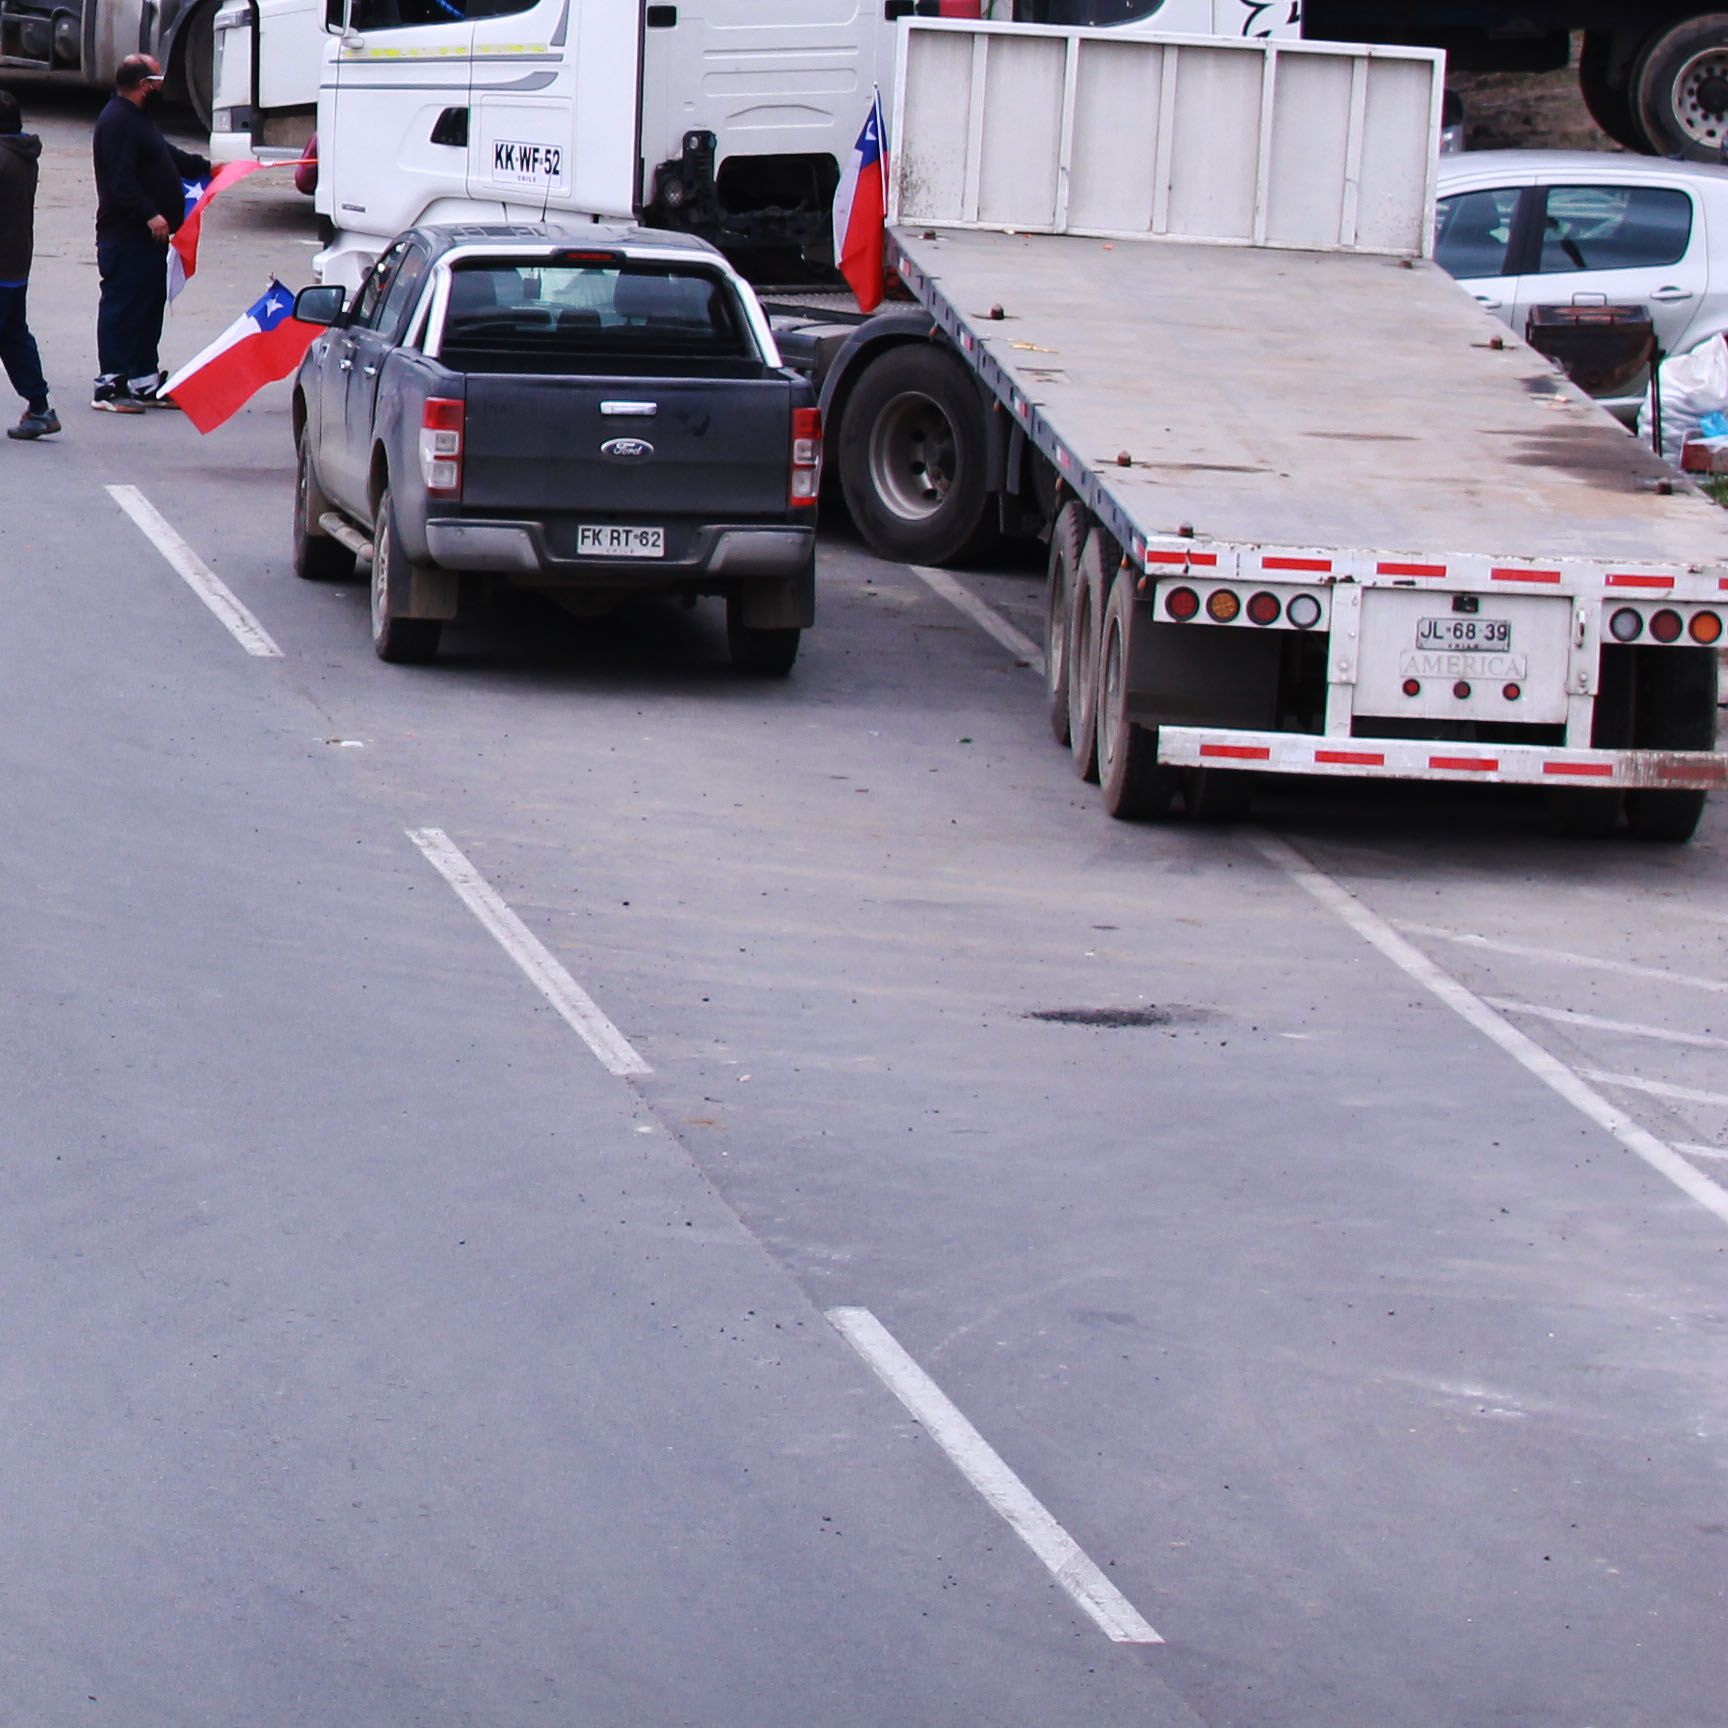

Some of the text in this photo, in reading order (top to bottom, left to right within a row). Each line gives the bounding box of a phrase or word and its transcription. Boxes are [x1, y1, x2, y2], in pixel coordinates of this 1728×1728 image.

[612, 441, 643, 456] Ford
[580, 527, 661, 548] FK RT 62
[1452, 622, 1476, 640] 68
[1484, 623, 1508, 642] 39
[1404, 654, 1522, 677] AMERICA
